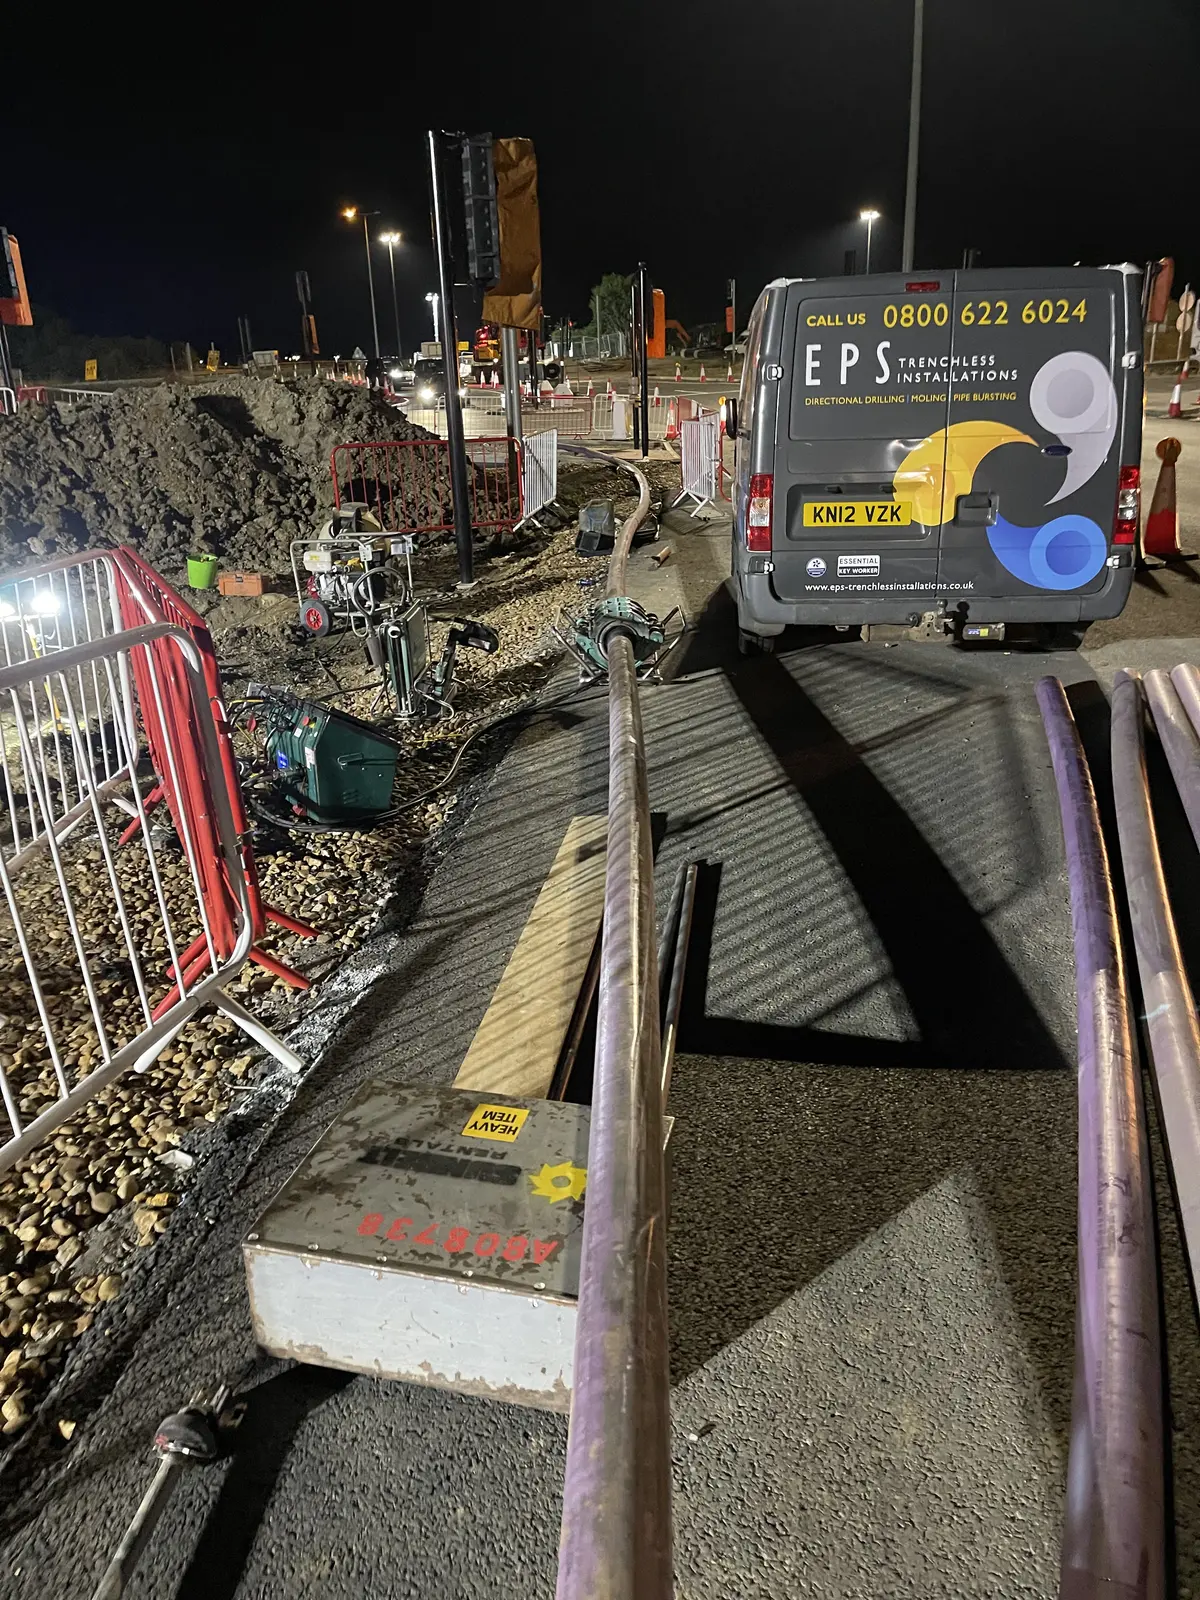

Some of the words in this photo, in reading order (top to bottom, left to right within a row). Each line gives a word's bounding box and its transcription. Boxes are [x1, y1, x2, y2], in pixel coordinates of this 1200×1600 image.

[807, 315, 843, 327] CALL
[847, 313, 867, 325] US
[884, 303, 948, 328] 0800
[961, 301, 1009, 326] 622
[1021, 298, 1087, 324] 6024
[898, 354, 995, 368] TRENCHLESS
[898, 369, 1018, 384] INSTALLATIONS
[806, 396, 863, 405] DIRECTIONAL
[865, 395, 904, 404] DRILLING
[911, 394, 947, 403] MOLING
[953, 393, 972, 402] PIPE
[973, 392, 1017, 401] BURSTING
[813, 506, 857, 523] KN12
[865, 505, 902, 523] VZK
[839, 557, 878, 565] ESSENTIAL
[852, 567, 879, 575] WORKER
[805, 581, 974, 592] www.eps-trenchlessinstallations.co.uk
[481, 1110, 517, 1123] ITEM
[467, 1120, 519, 1136] HEAVY
[358, 1212, 558, 1265] A808738
